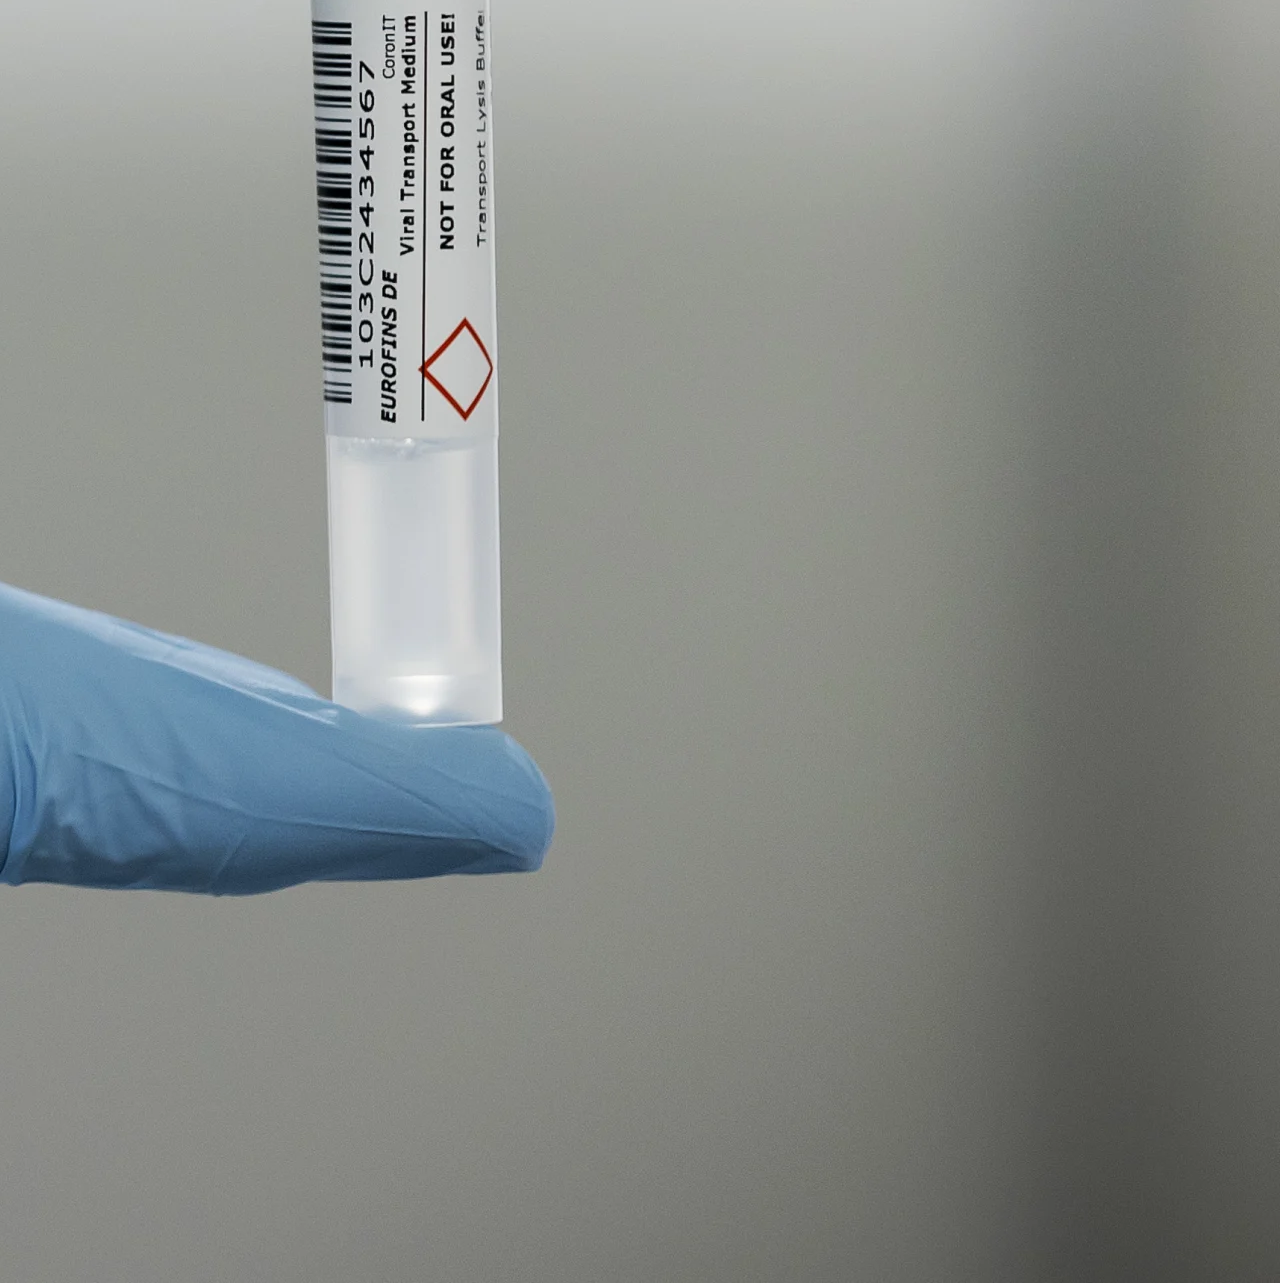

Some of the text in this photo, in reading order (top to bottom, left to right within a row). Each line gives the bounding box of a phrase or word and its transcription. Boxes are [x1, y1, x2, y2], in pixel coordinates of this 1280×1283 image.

[382, 15, 395, 79] CoronIT
[476, 80, 487, 132] Lysis
[400, 16, 419, 256] Viral Transport Medium
[440, 14, 455, 249] NOT FOR ORAL USE!
[477, 141, 487, 247] Transport
[359, 61, 374, 368] 103C2434567
[381, 270, 397, 423] EUROFINS DE
